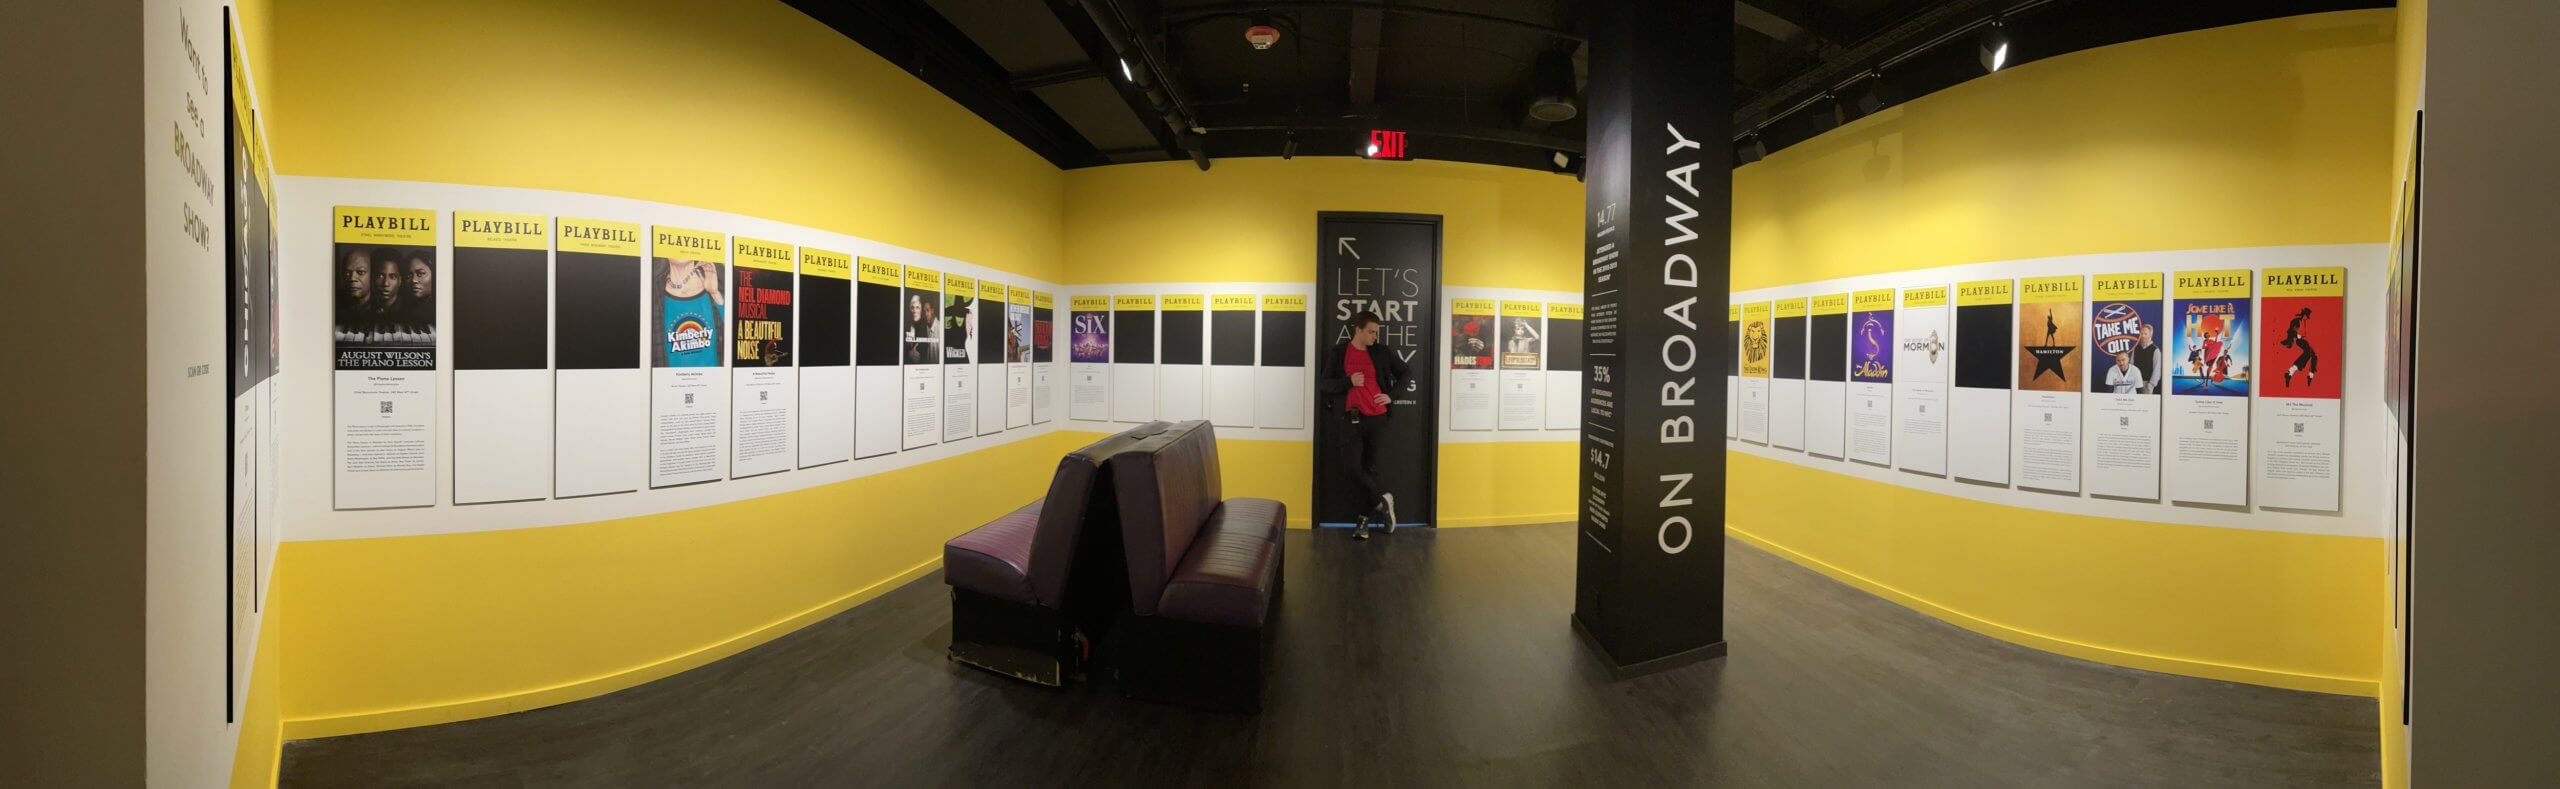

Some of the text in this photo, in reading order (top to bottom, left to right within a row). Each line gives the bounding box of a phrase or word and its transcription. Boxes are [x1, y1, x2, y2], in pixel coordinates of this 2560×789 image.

[180, 6, 208, 96] Want to
[187, 91, 204, 139] see a
[1371, 129, 1406, 157] EXIT
[175, 120, 214, 207] BROADWAY
[342, 215, 430, 231] PLAYBILL
[1597, 202, 1617, 228] 14.77
[184, 201, 209, 252] SHOW?
[462, 219, 542, 235] PLAYBILL
[564, 226, 636, 243] PLAYBILL
[659, 233, 721, 251] PLAYBILL
[739, 244, 791, 260] PLAYBILL
[804, 254, 848, 269] PLAYBILL
[739, 270, 752, 286] THE
[862, 263, 899, 278] PLAYBILL
[908, 270, 939, 283] PLAYBILL
[947, 278, 974, 290] PLAYBILL
[1338, 267, 1419, 298] LET'S
[2024, 281, 2079, 293] PLAYBILL
[2097, 279, 2158, 290] PLAYBILL
[2179, 276, 2245, 288] PLAYBILL
[2268, 274, 2338, 286] PLAYBILL
[738, 286, 791, 306] NEIL DIAMOND
[1855, 294, 1891, 304] PLAYBILL
[1904, 290, 1946, 301] PLAYBILL
[1960, 285, 2009, 297] PLAYBILL
[1215, 297, 1253, 305] PLAYBILL
[1456, 302, 1493, 310] PLAYBILL
[1504, 303, 1540, 312] PLAYBILL
[1776, 301, 1805, 311] PLAYBILL
[1813, 298, 1845, 308] PLAYBILL
[2187, 303, 2209, 314] SOME
[2209, 303, 2225, 313] LIKE
[738, 303, 768, 319] MUSICAL
[1336, 299, 1419, 322] START
[738, 320, 783, 340] A BEAUTIFUL
[2095, 316, 2139, 340] TAKE ME
[2186, 314, 2236, 338] HOT
[668, 327, 713, 342] Kimberly
[1658, 122, 1700, 555] ON BROADWAY
[672, 338, 710, 352] Akimbo
[737, 340, 760, 360] NOISE
[2108, 338, 2130, 353] OUT
[338, 359, 433, 367] THE PIANO LESSON
[341, 351, 431, 360] AUGUST WILSON'S
[1593, 365, 1611, 384] 35%
[1590, 447, 1610, 470] $14.7
